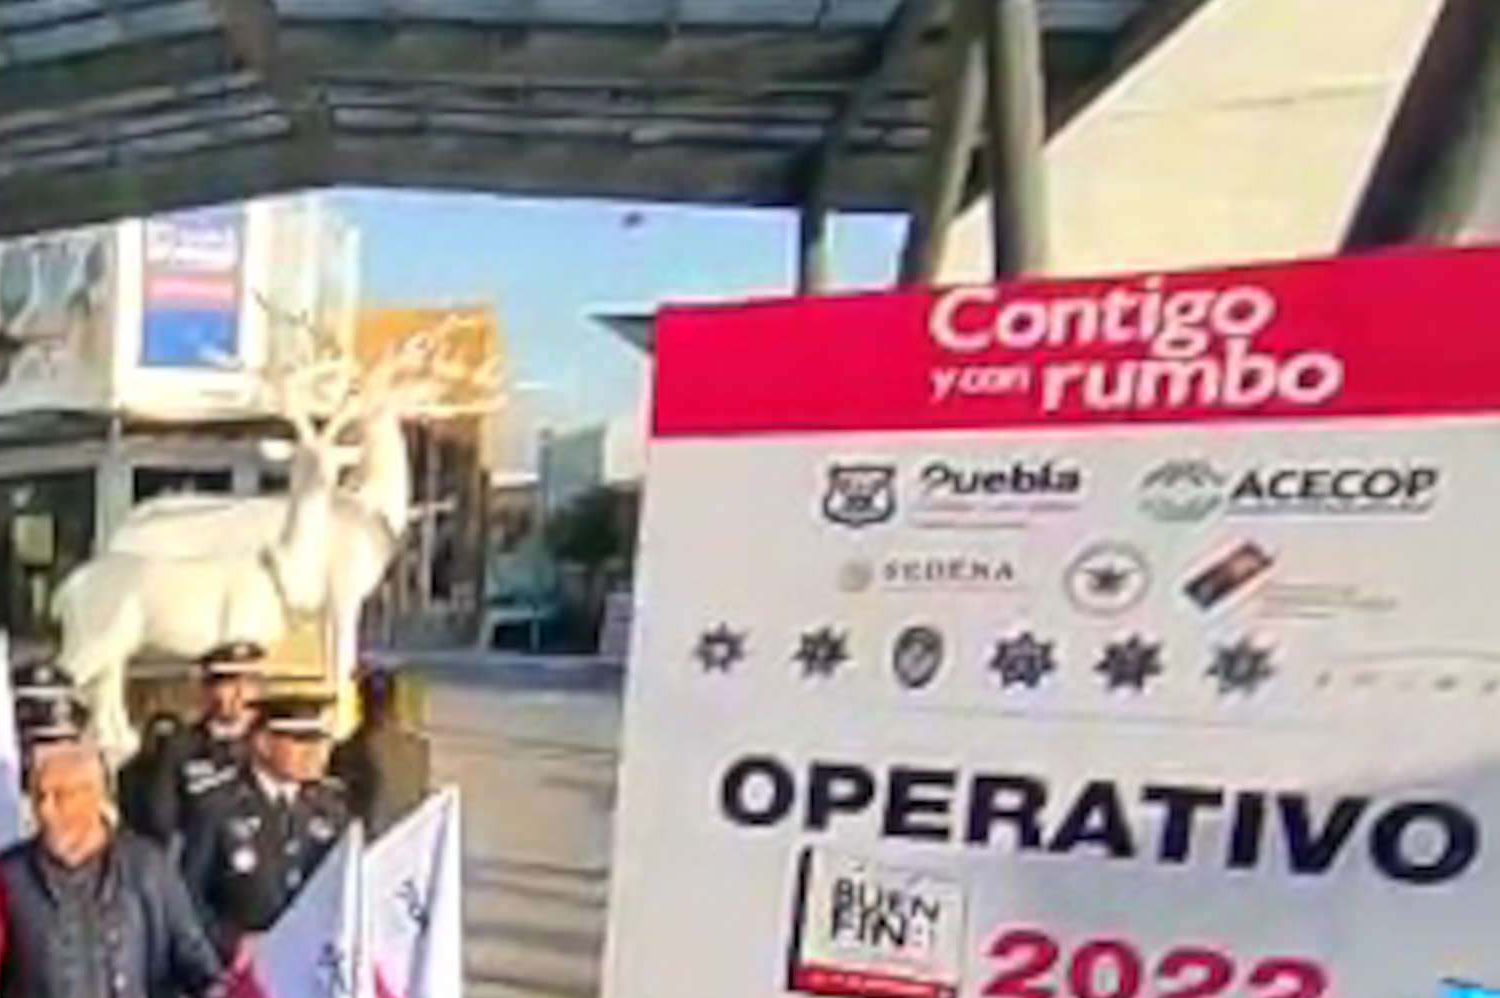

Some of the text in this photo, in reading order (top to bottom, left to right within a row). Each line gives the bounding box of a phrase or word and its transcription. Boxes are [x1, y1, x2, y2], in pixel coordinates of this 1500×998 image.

[930, 276, 1275, 358] Contigo
[930, 367, 957, 401] y
[1043, 338, 1344, 412] rumbo
[920, 462, 1080, 495] Puebla
[1230, 469, 1439, 500] ACECOP
[883, 559, 1014, 582] SEDENA
[721, 755, 1481, 884] OPERATIVO
